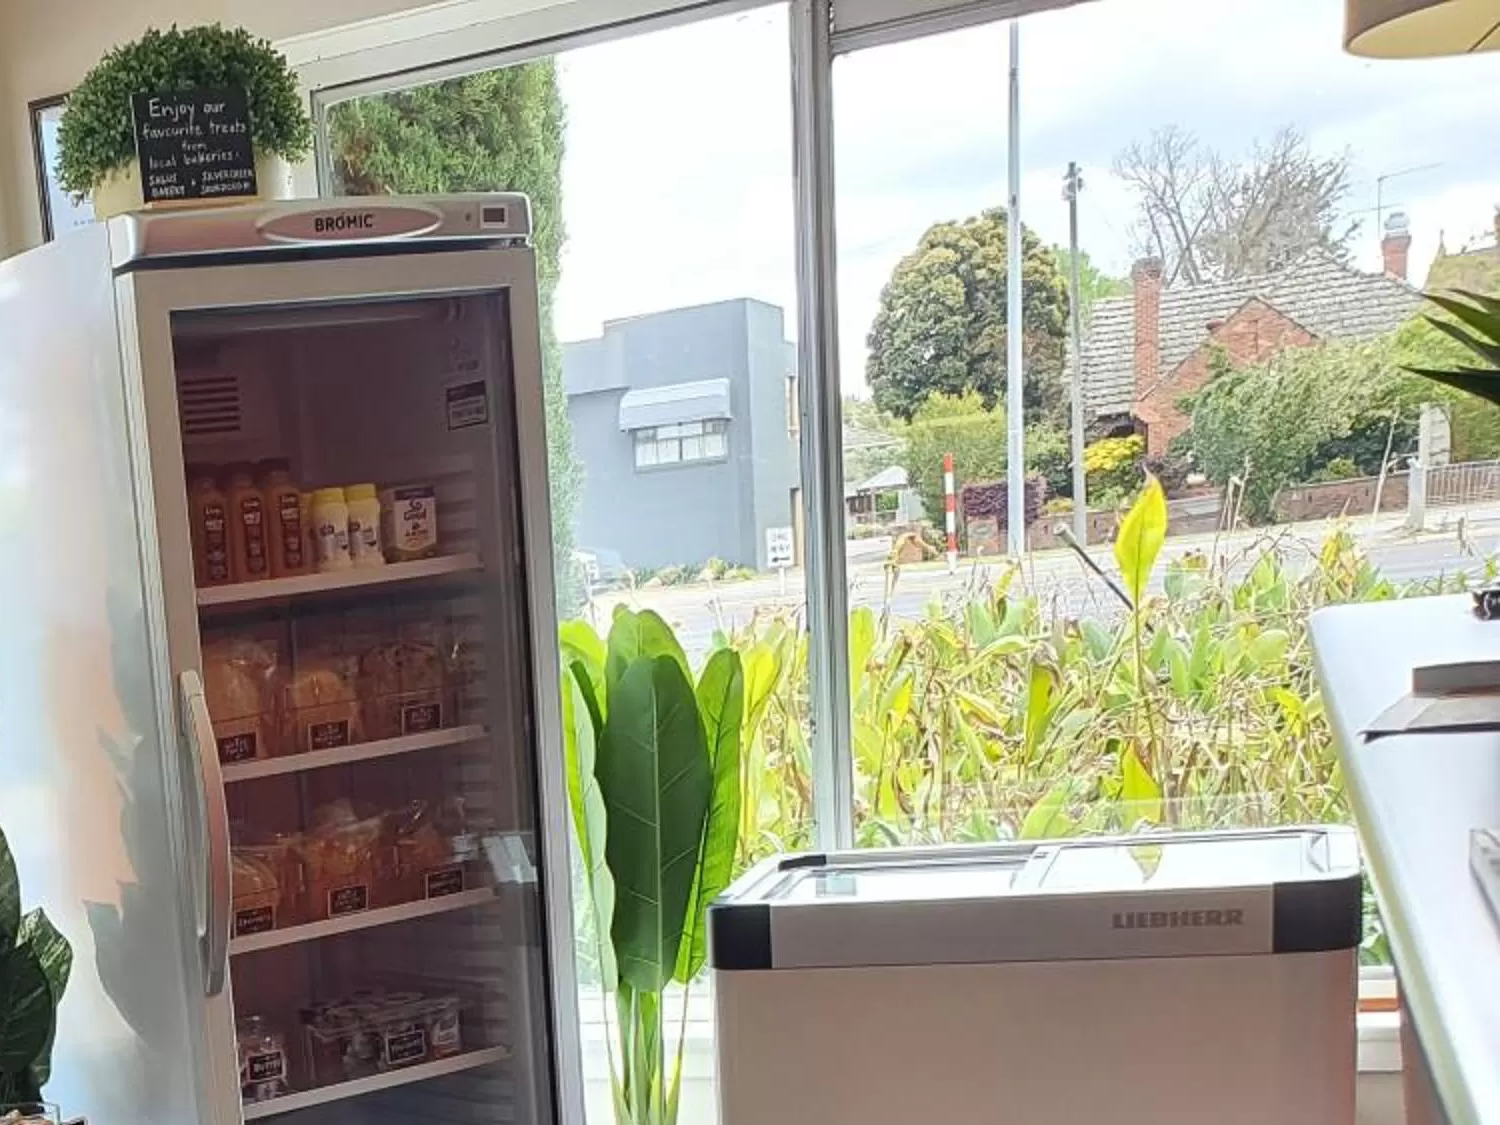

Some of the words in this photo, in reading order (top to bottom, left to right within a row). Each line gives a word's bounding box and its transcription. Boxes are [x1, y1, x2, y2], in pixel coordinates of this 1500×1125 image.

[148, 95, 195, 125] Enjoy
[203, 101, 226, 113] our
[142, 122, 203, 139] favourite
[209, 117, 246, 135] treats
[1111, 909, 1244, 929] LIEBHERR
